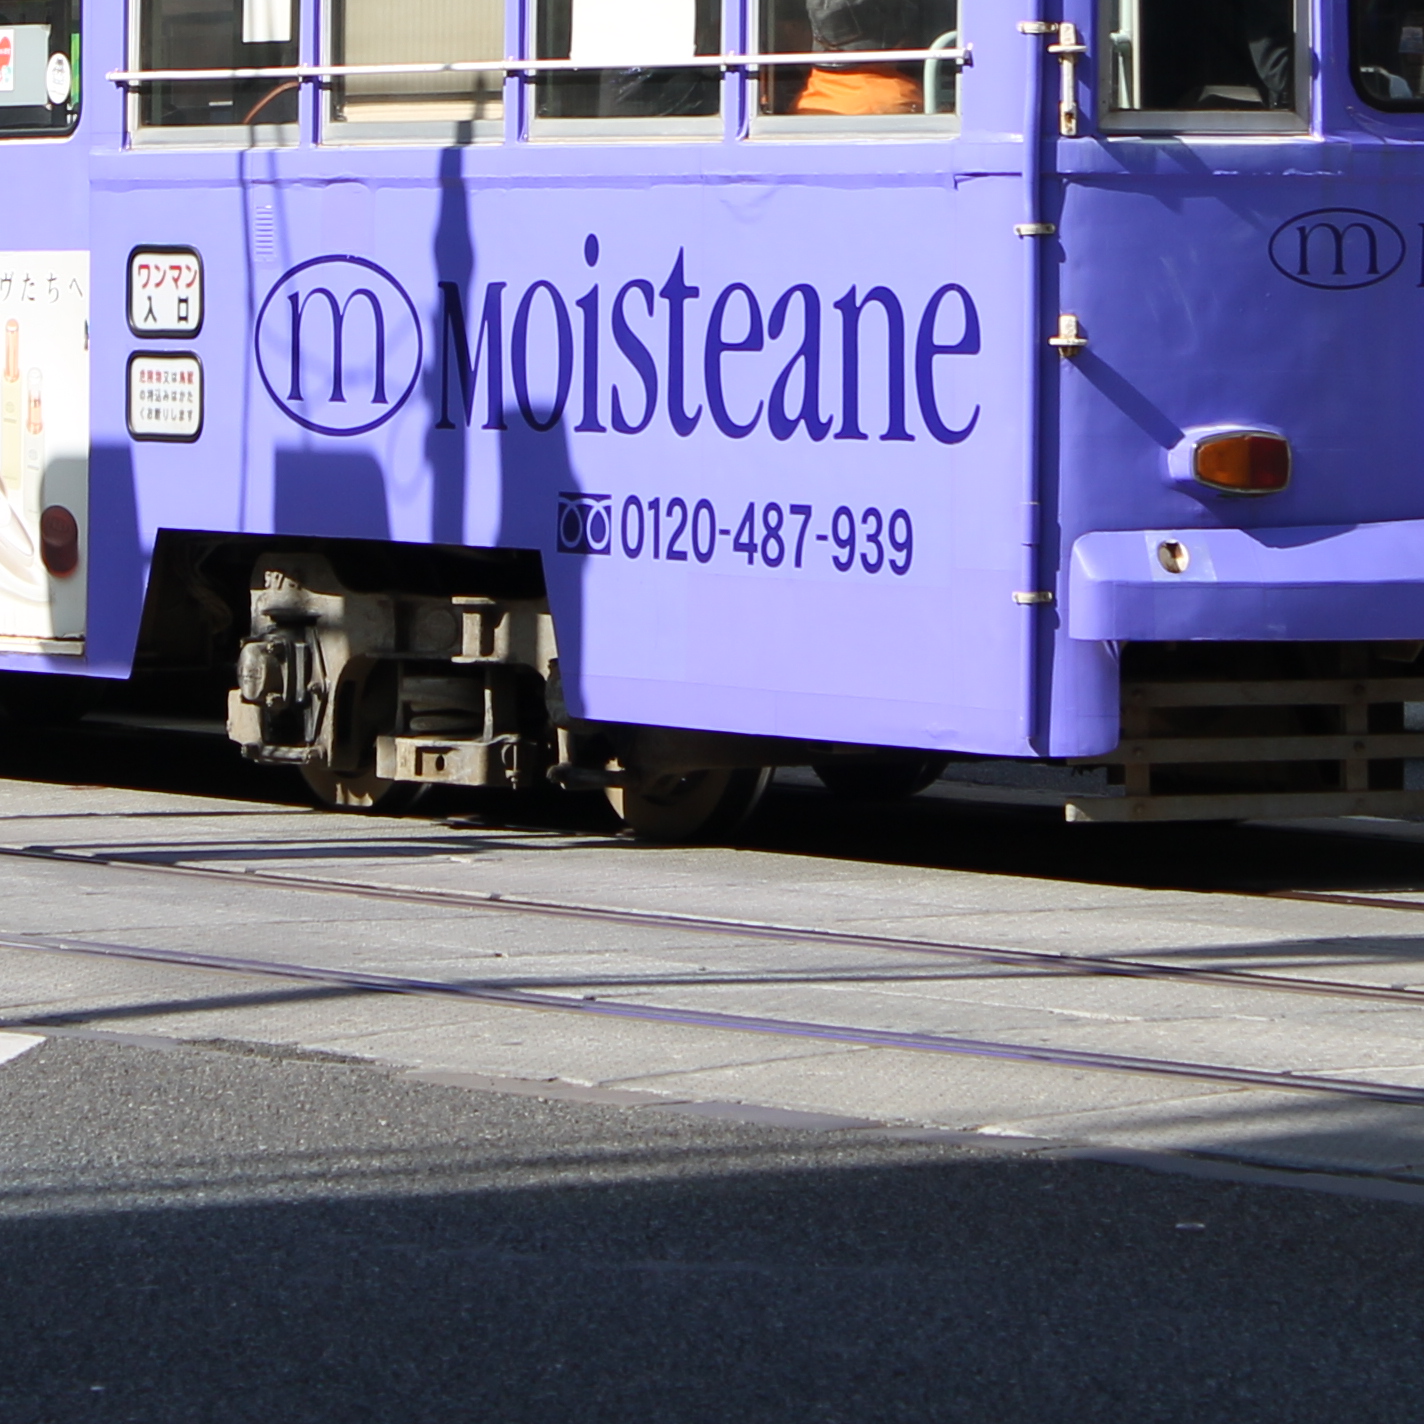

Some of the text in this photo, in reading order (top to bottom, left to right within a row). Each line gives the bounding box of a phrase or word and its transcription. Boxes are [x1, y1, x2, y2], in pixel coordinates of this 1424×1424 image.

[138, 263, 198, 291] ワンマン
[143, 295, 189, 324] 入口
[435, 233, 981, 446] Moisteane
[621, 494, 913, 577] 0120-487-939
